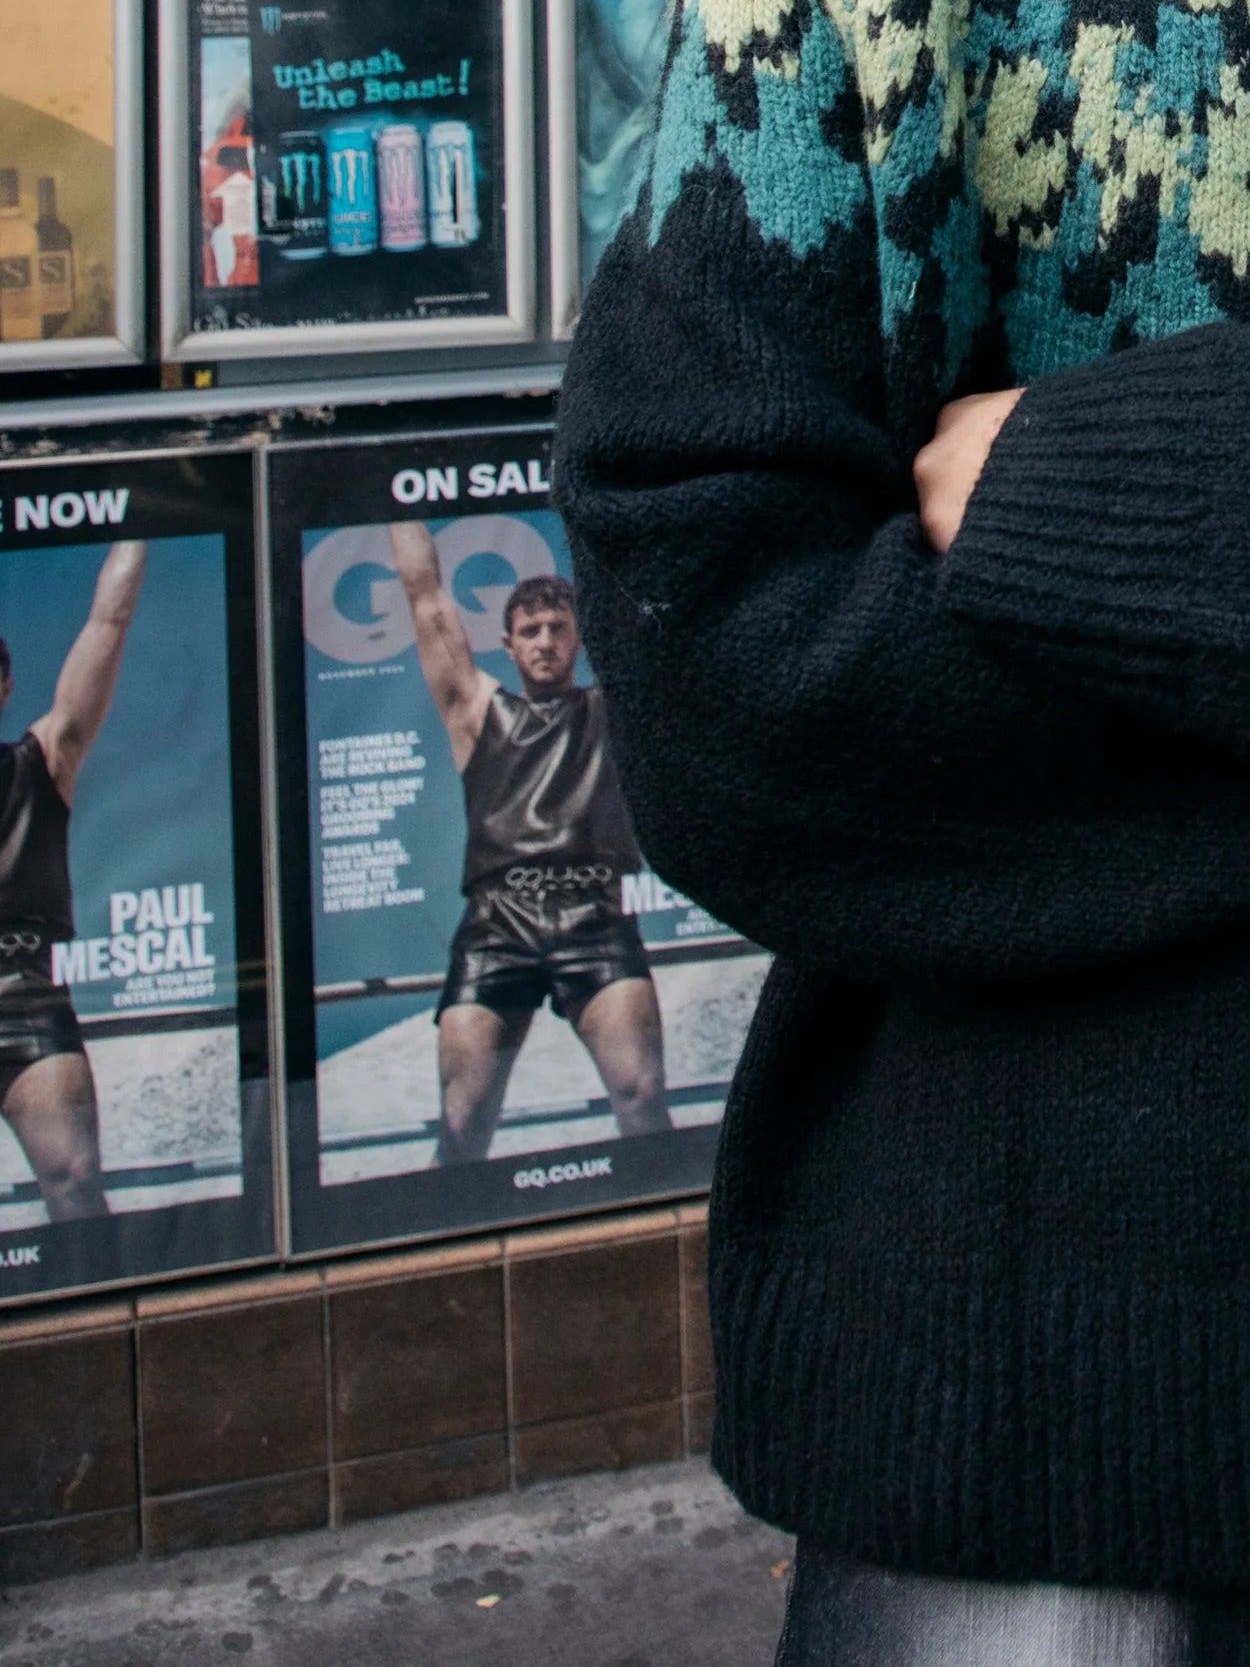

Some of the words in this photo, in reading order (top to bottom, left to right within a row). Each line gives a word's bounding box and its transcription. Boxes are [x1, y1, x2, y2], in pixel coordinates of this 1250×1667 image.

[298, 84, 358, 110] the
[391, 467, 459, 505] ON
[467, 459, 550, 496] SAL
[15, 488, 130, 531] NOW
[303, 515, 557, 664] GQ
[110, 882, 215, 935] PAUL
[51, 925, 216, 987] MESCAL
[513, 1156, 613, 1189] GQ.CO.UK
[0, 1244, 41, 1268] .UK
